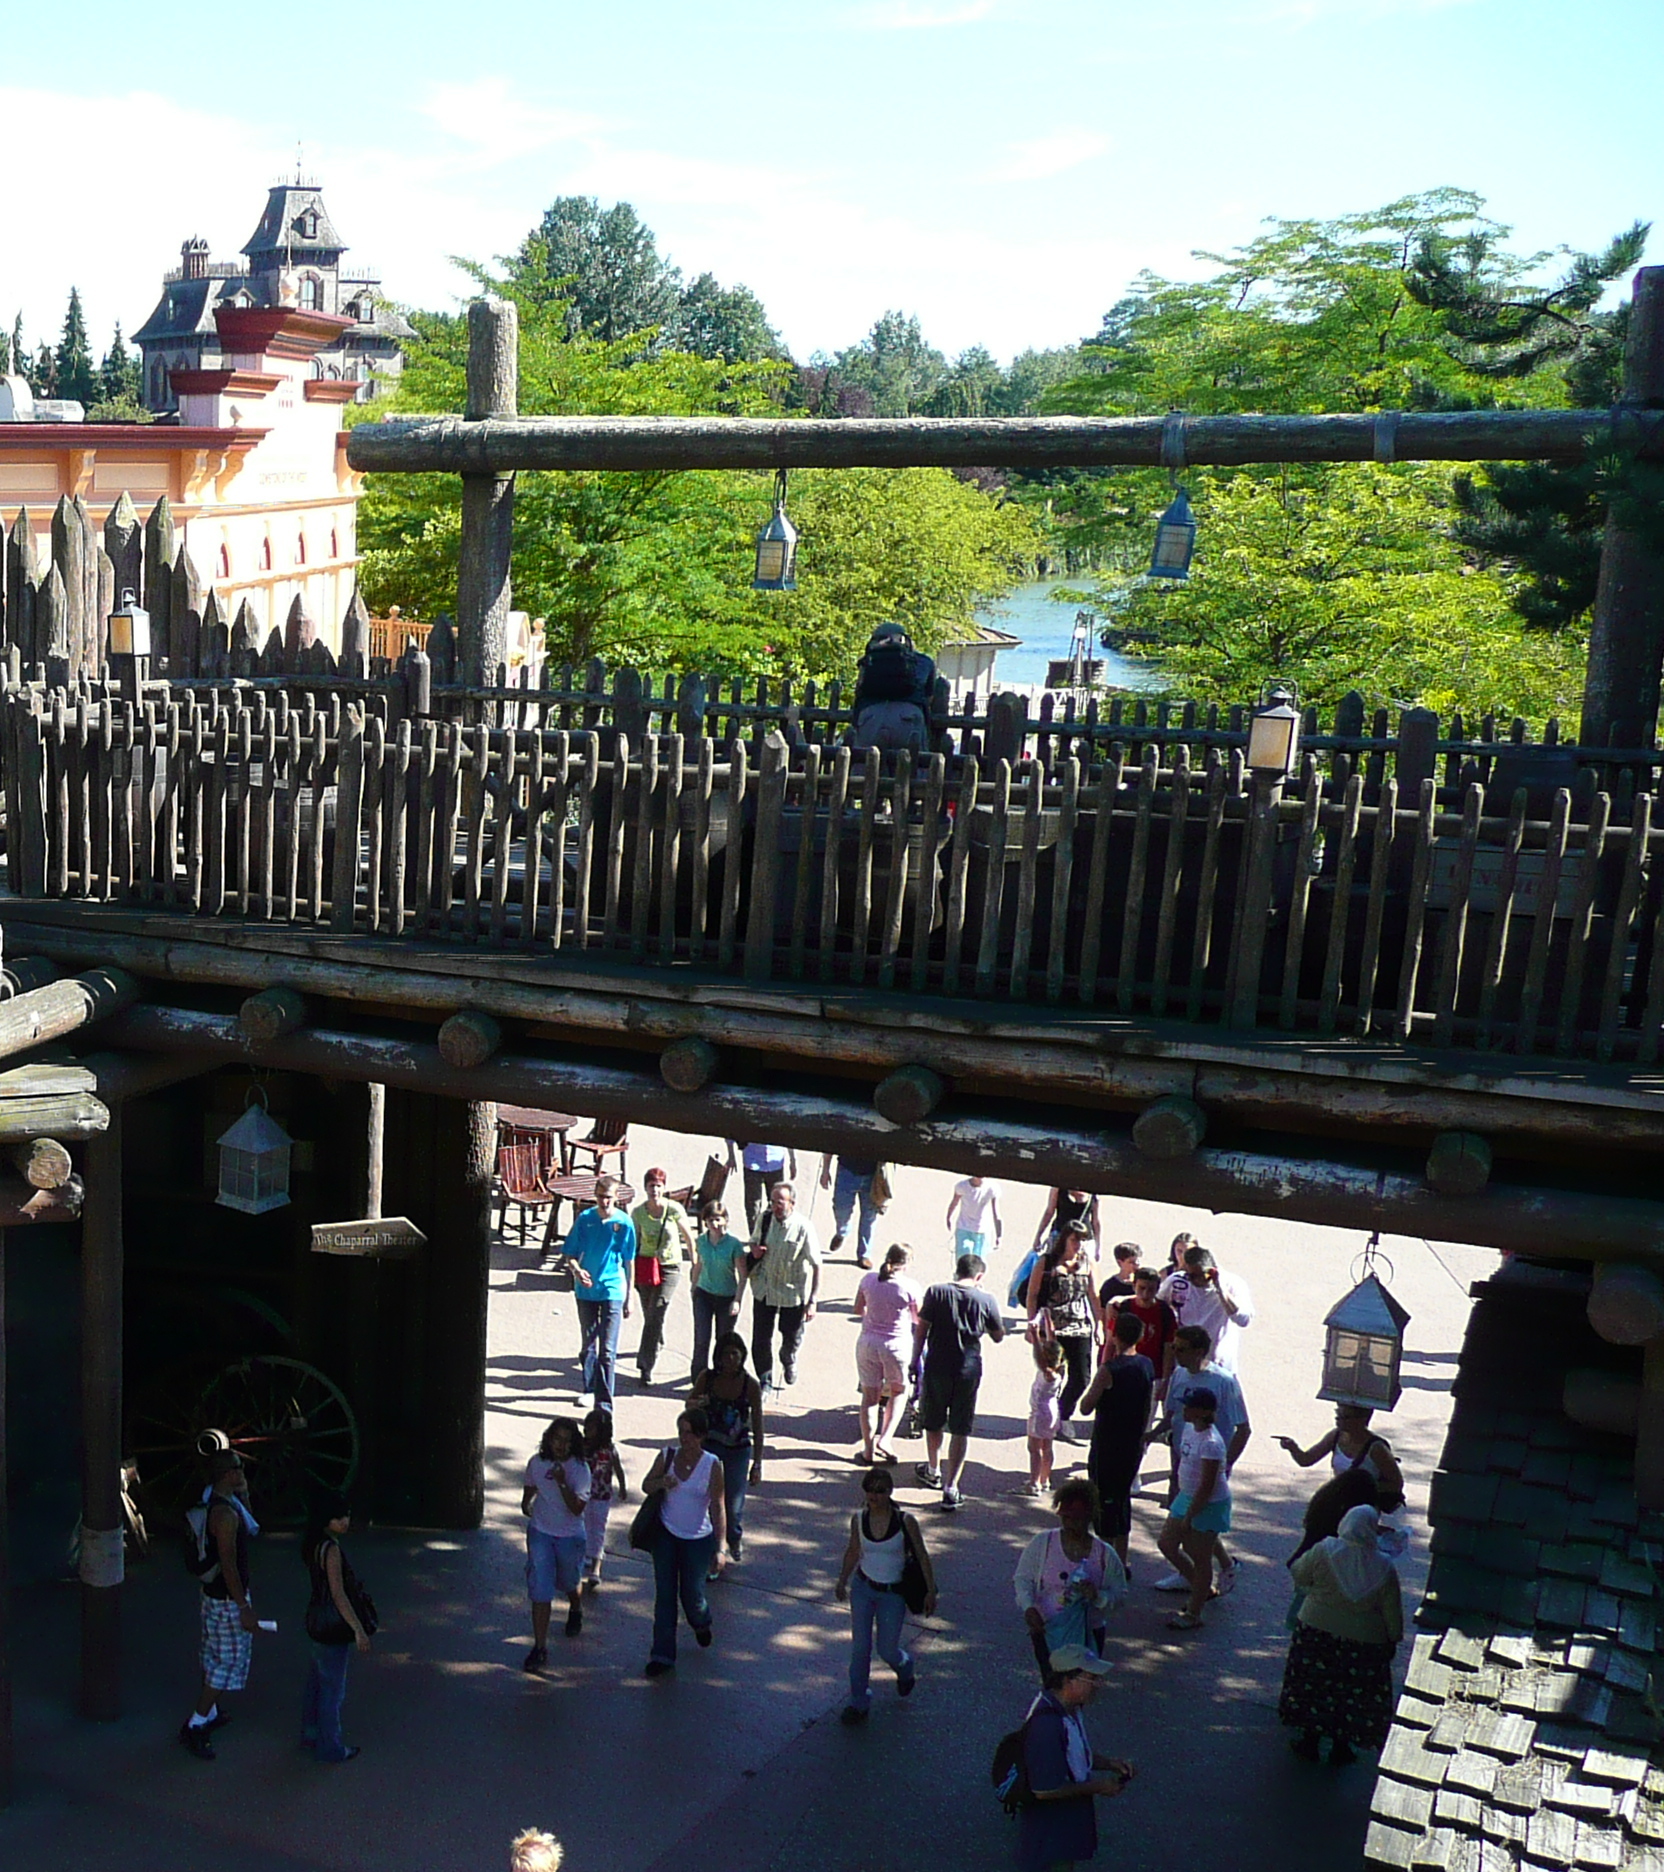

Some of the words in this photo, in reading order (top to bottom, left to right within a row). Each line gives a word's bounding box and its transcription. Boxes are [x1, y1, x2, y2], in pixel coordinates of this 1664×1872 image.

[316, 1233, 332, 1246] The
[334, 1233, 378, 1250] Chaparral
[382, 1232, 417, 1246] Theater
